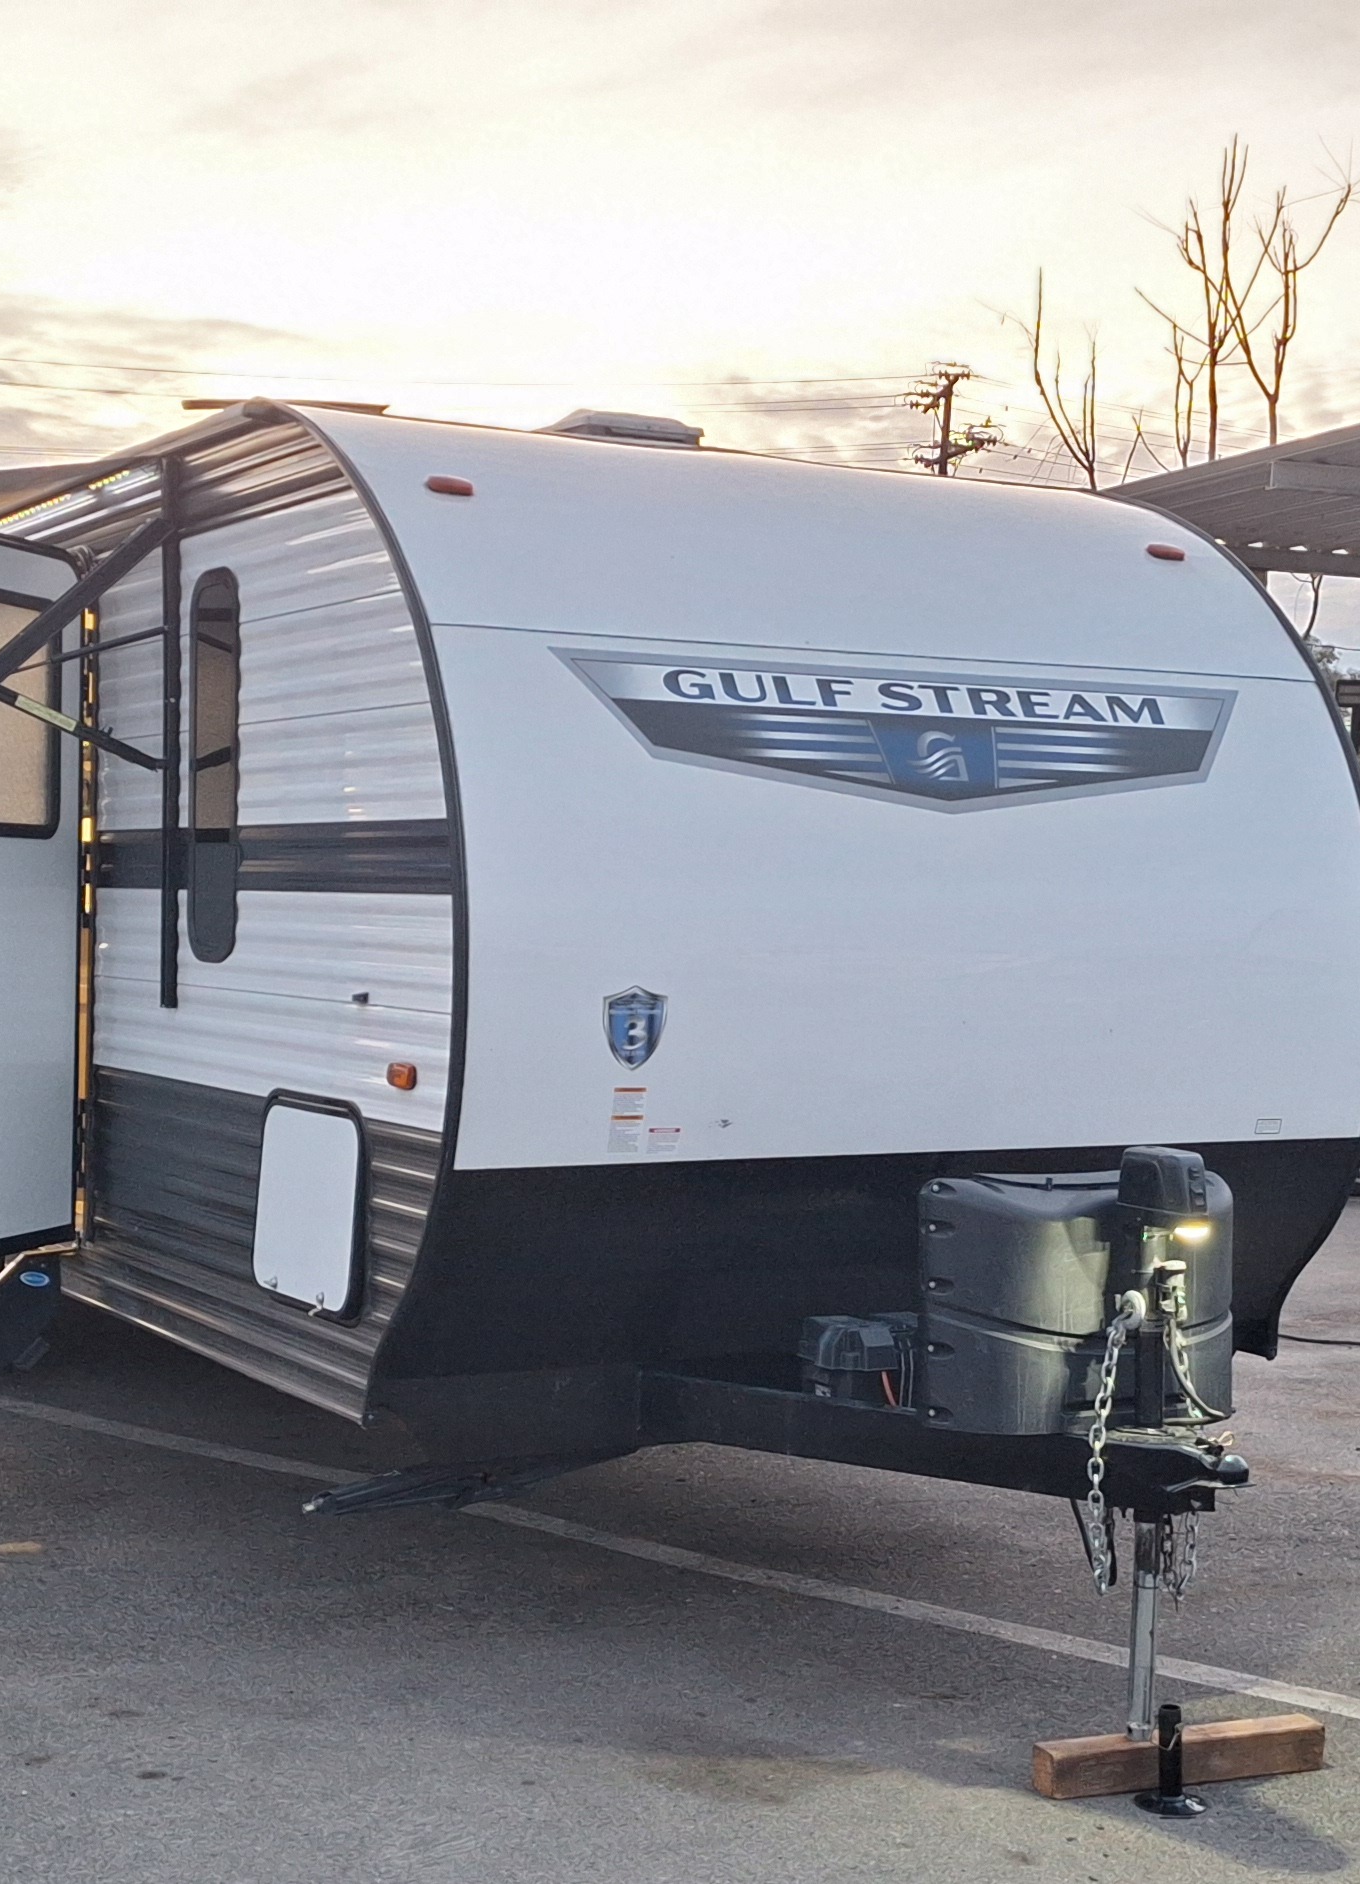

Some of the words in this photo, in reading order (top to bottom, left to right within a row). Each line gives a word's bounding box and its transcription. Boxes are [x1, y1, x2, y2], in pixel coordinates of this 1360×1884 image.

[662, 668, 855, 708] GULF
[878, 681, 1166, 726] STREAM
[623, 1015, 648, 1051] 3
